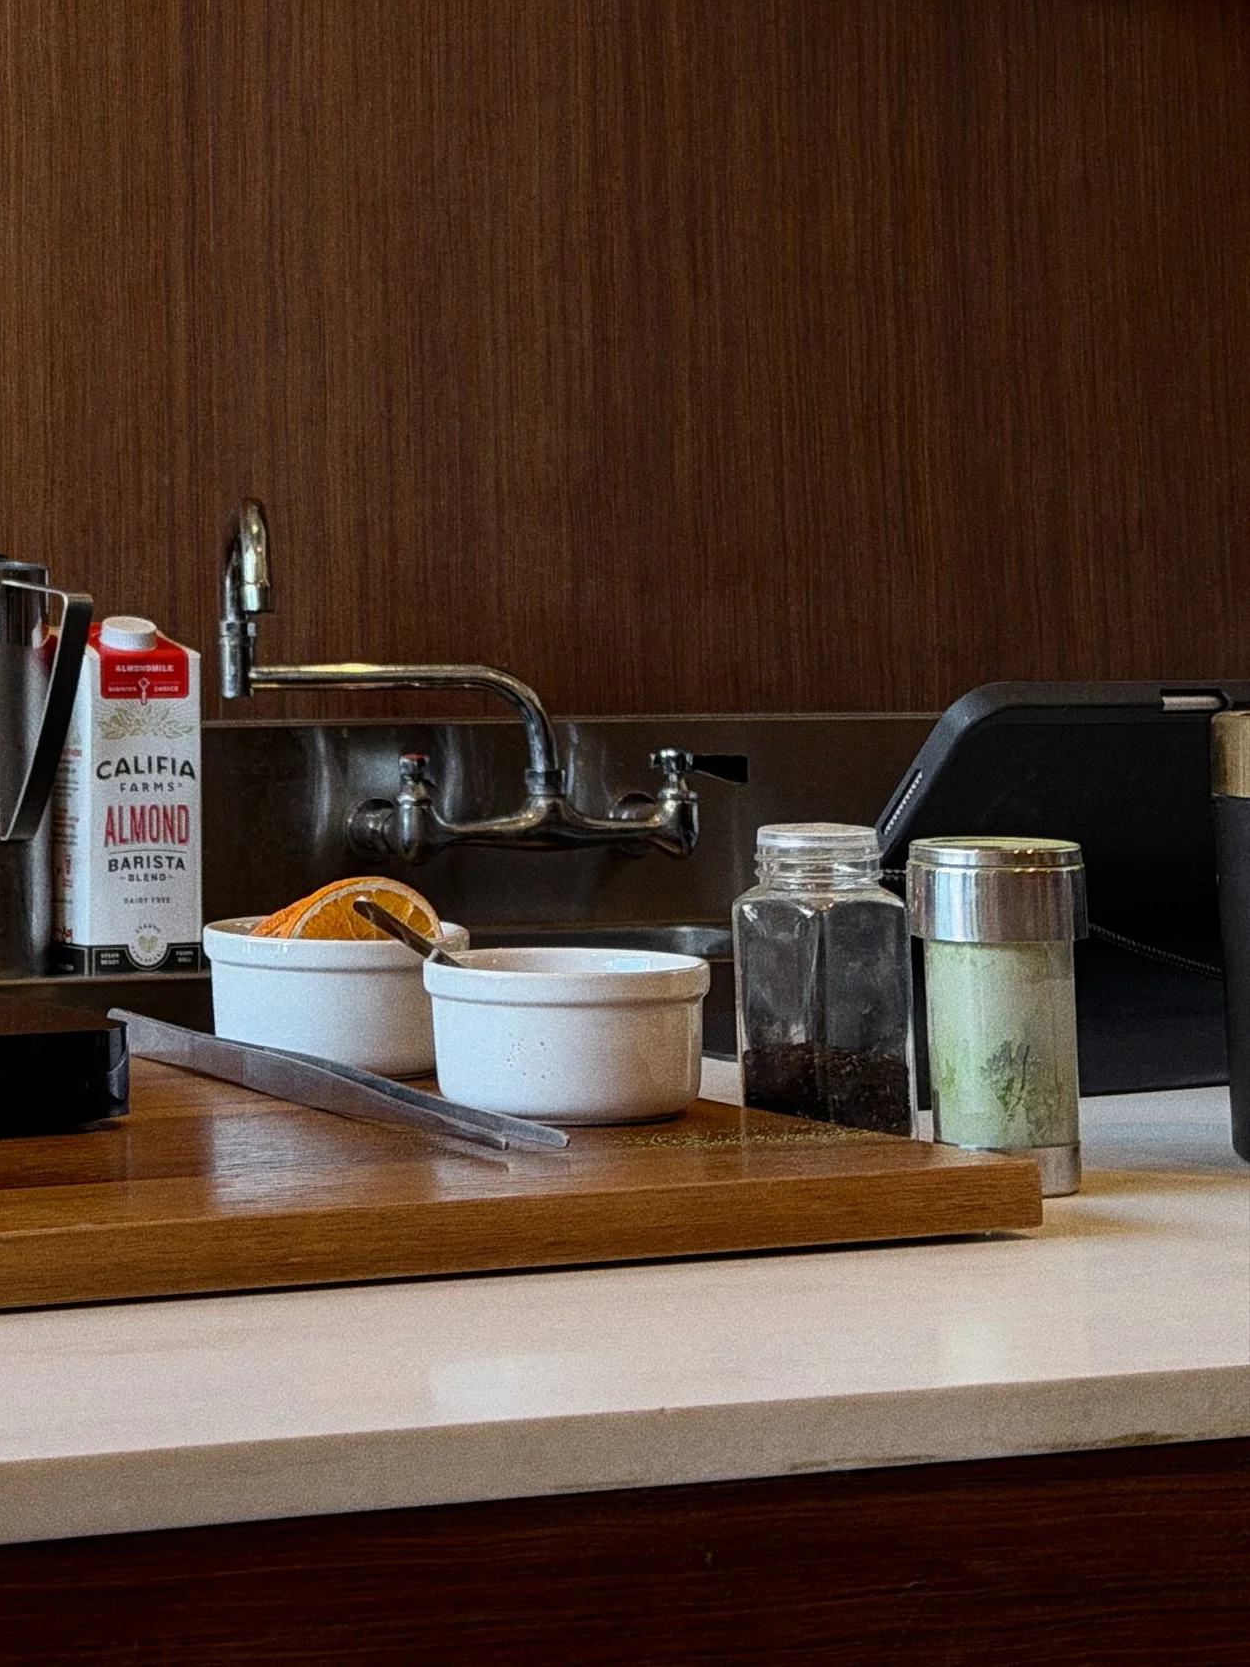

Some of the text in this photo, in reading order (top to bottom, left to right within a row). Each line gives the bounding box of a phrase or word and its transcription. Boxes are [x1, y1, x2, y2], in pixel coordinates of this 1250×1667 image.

[96, 755, 196, 781] CALIFIA
[104, 804, 189, 848] ALMOND
[107, 855, 186, 873] BARISTA
